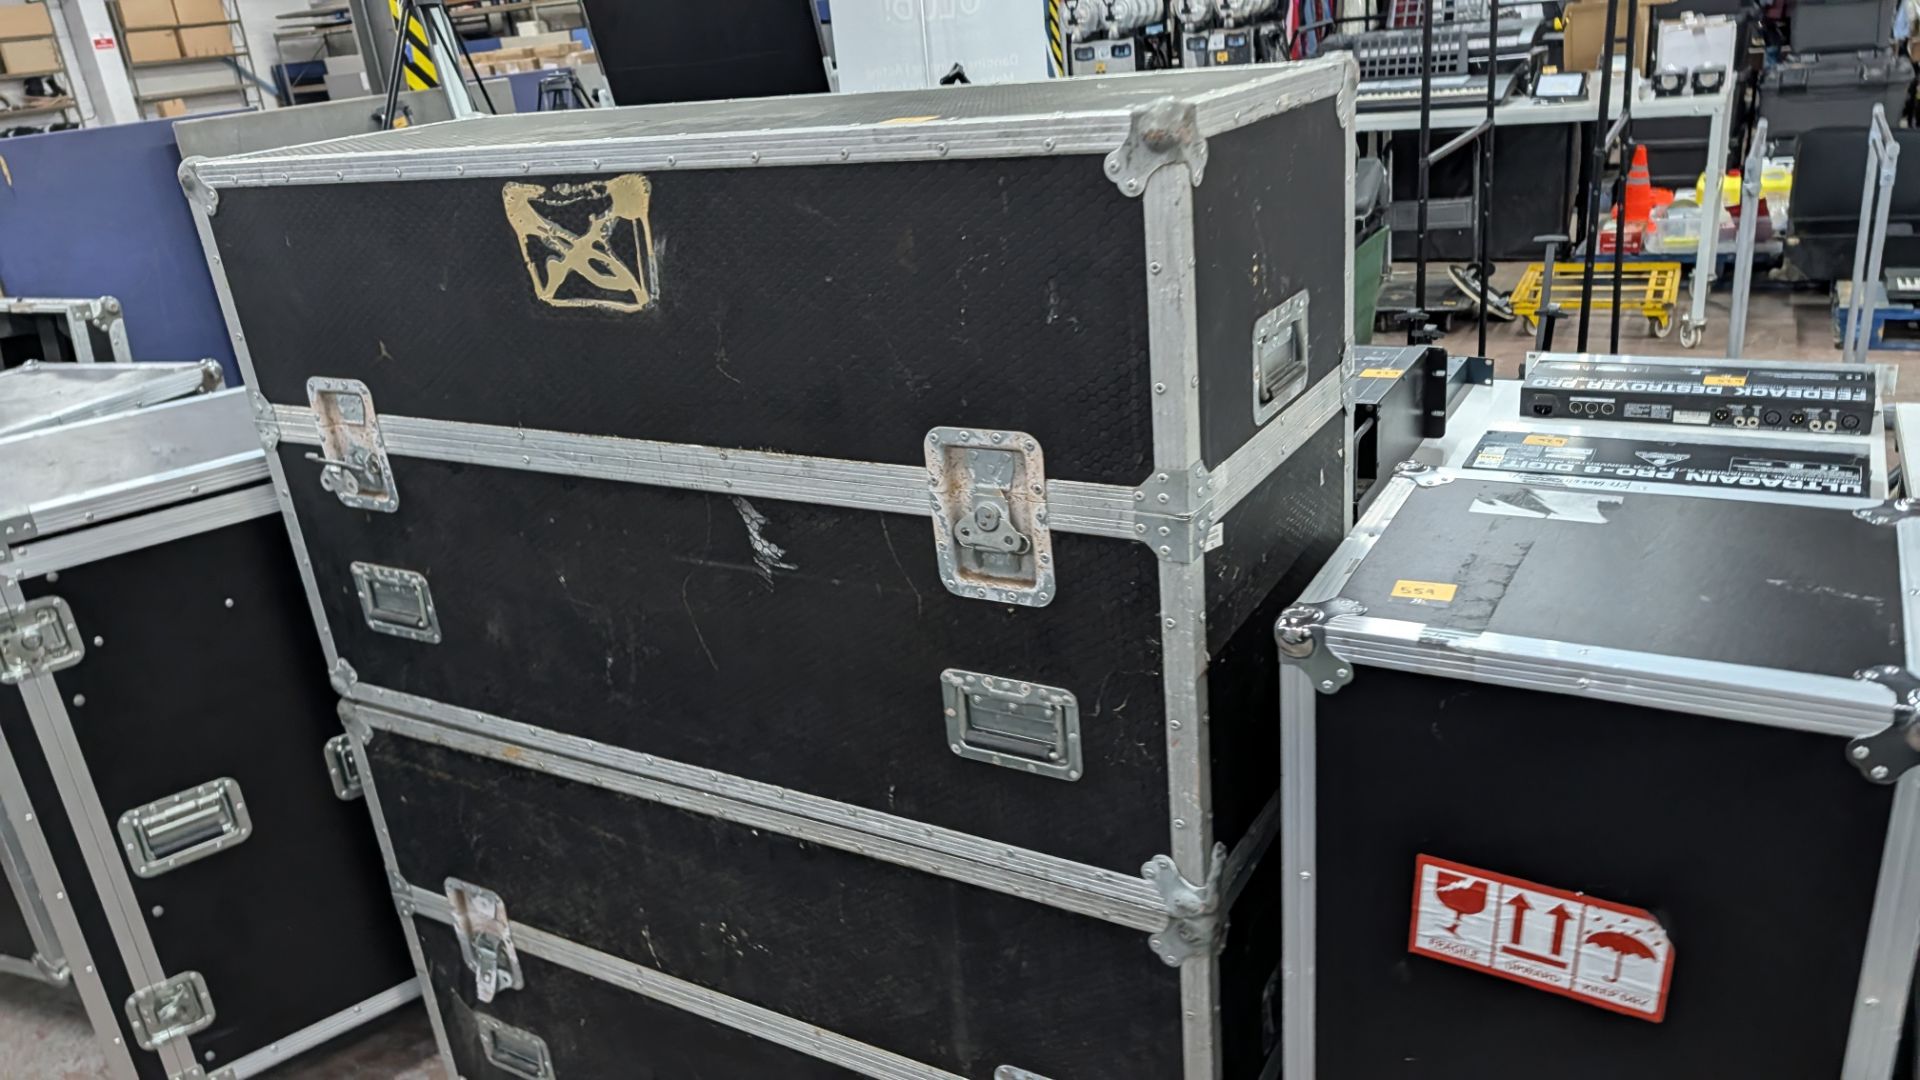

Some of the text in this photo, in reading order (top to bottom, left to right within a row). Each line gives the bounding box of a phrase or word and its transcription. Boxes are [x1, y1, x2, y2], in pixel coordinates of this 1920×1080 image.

[1530, 377, 1867, 402] FEEDBACK DESTROYER PRO
[1685, 473, 1862, 494] ULTRAGAIN
